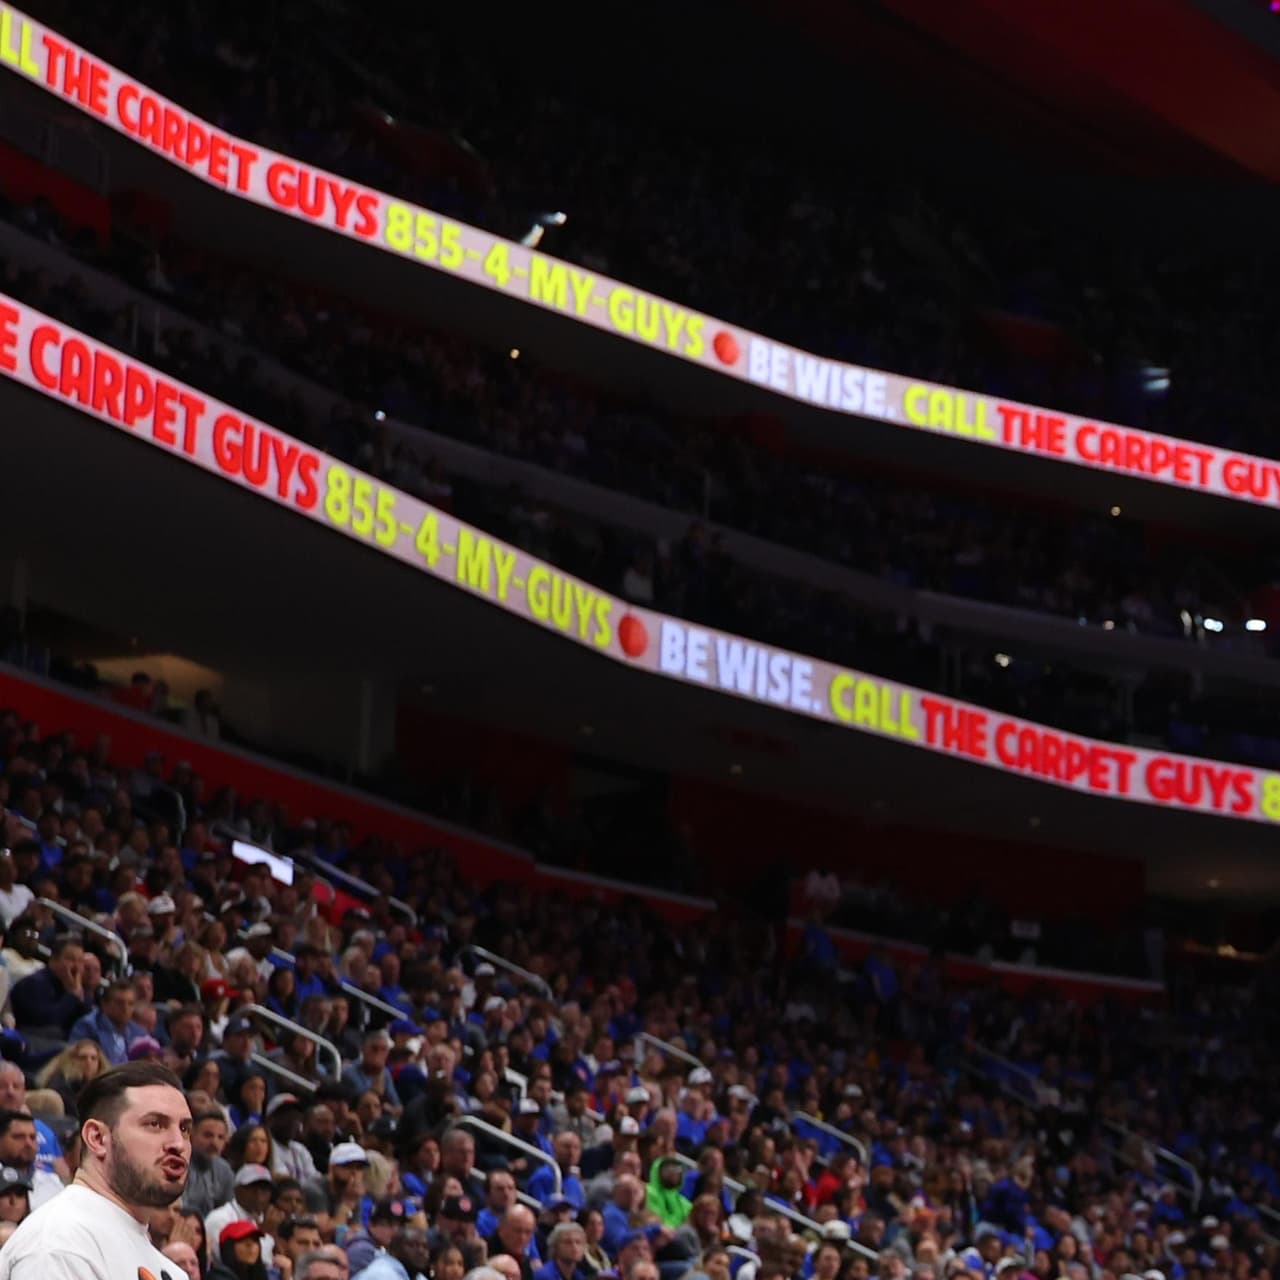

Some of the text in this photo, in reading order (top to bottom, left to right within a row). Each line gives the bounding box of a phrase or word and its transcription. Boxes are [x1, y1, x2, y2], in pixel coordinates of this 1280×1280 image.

[0, 8, 41, 78] LL
[42, 34, 110, 118] THE
[116, 83, 259, 193] CARPET
[265, 160, 381, 239] GUYS
[384, 203, 705, 358] 855-4-MY-GUYS
[749, 336, 789, 391] BE
[795, 354, 898, 419] WISE.
[903, 384, 995, 440] CALL
[997, 404, 1068, 458] THE
[1074, 423, 1216, 487] CARPET
[28, 323, 207, 457] CARPET
[212, 411, 321, 512] GUYS
[323, 465, 613, 650] 855-4-MY-GUYS
[660, 619, 710, 682] BE
[715, 636, 824, 713] WISE.
[828, 672, 920, 741] CALL
[919, 695, 990, 762] THE
[993, 719, 1139, 795] CARPET
[1144, 755, 1256, 818] GUYS
